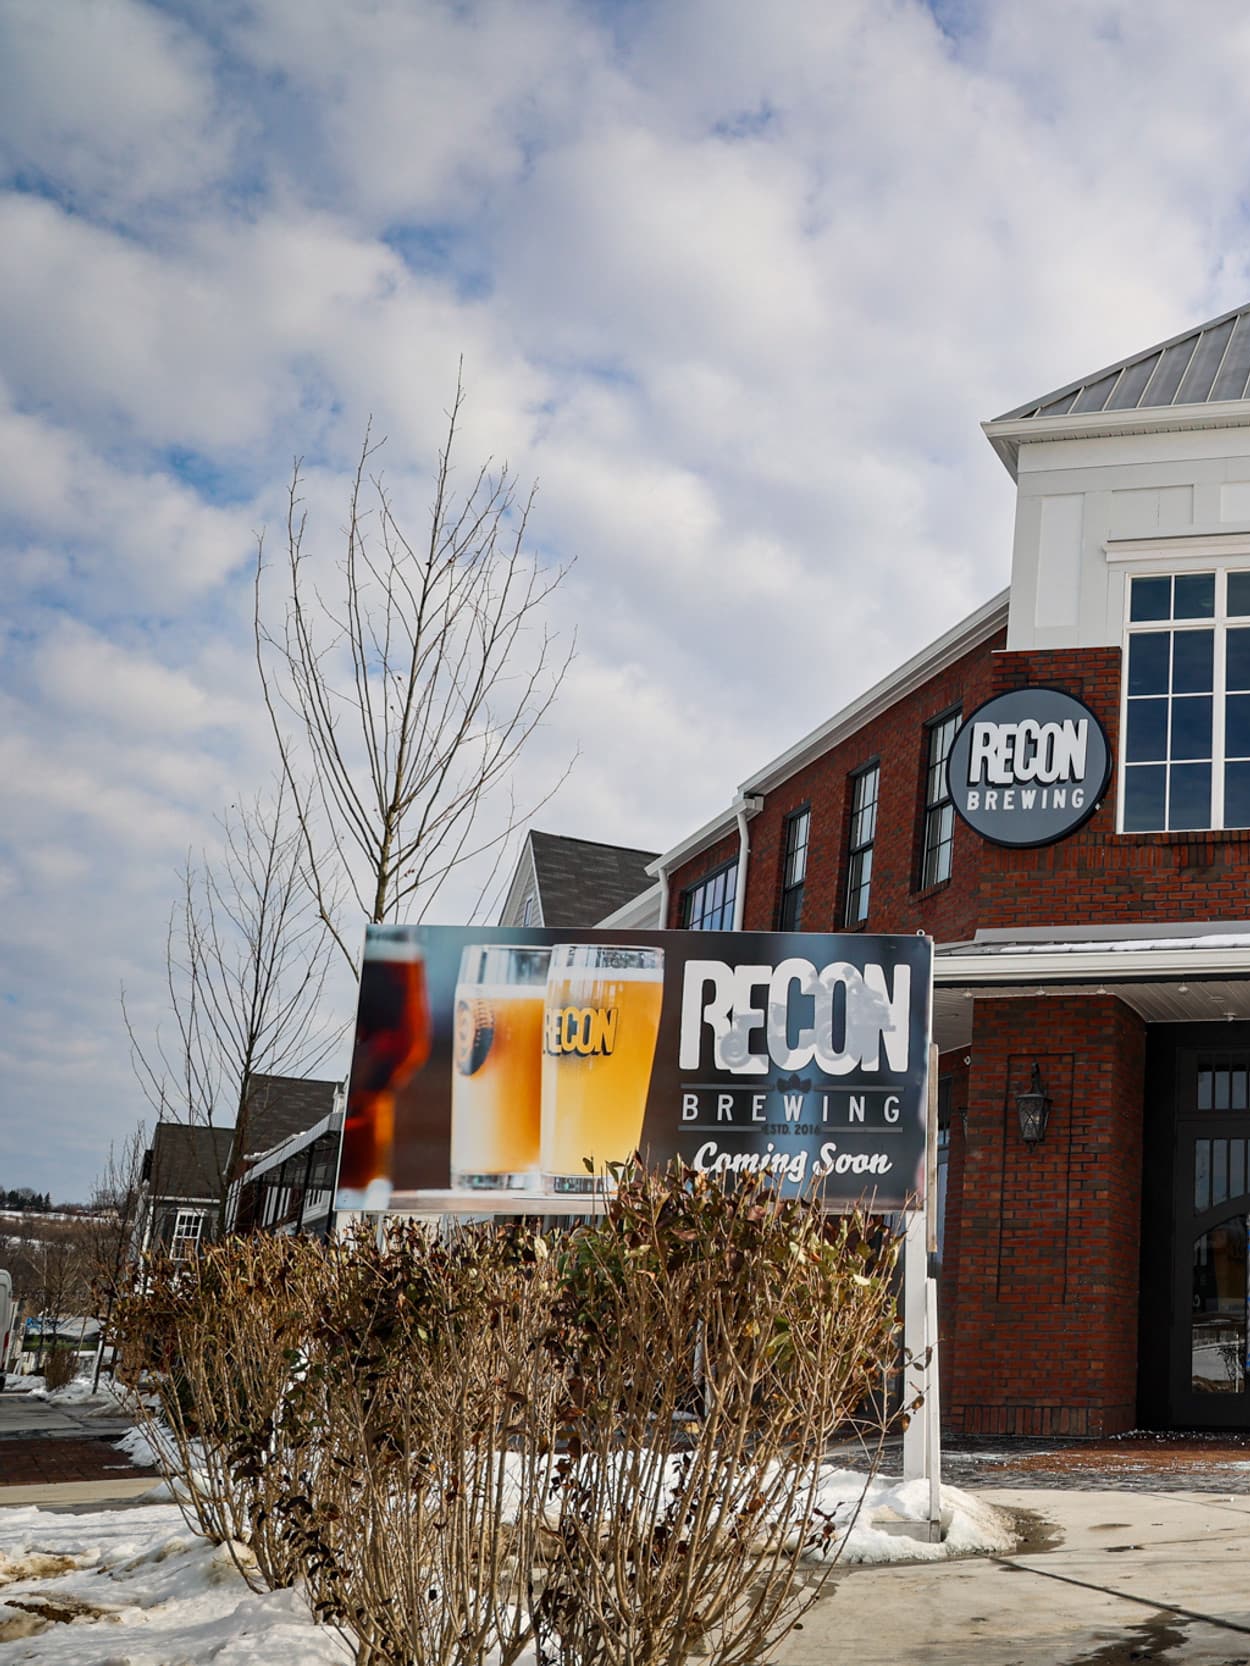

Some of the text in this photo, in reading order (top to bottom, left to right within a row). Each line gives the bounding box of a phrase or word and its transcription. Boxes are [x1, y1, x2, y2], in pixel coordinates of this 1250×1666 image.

[967, 719, 1089, 786] RECON
[966, 788, 1085, 811] BREWING
[543, 1006, 618, 1057] RECON
[679, 958, 911, 1075] RECON
[682, 1093, 901, 1123] BREWING
[693, 1141, 893, 1183] Coming Soon
